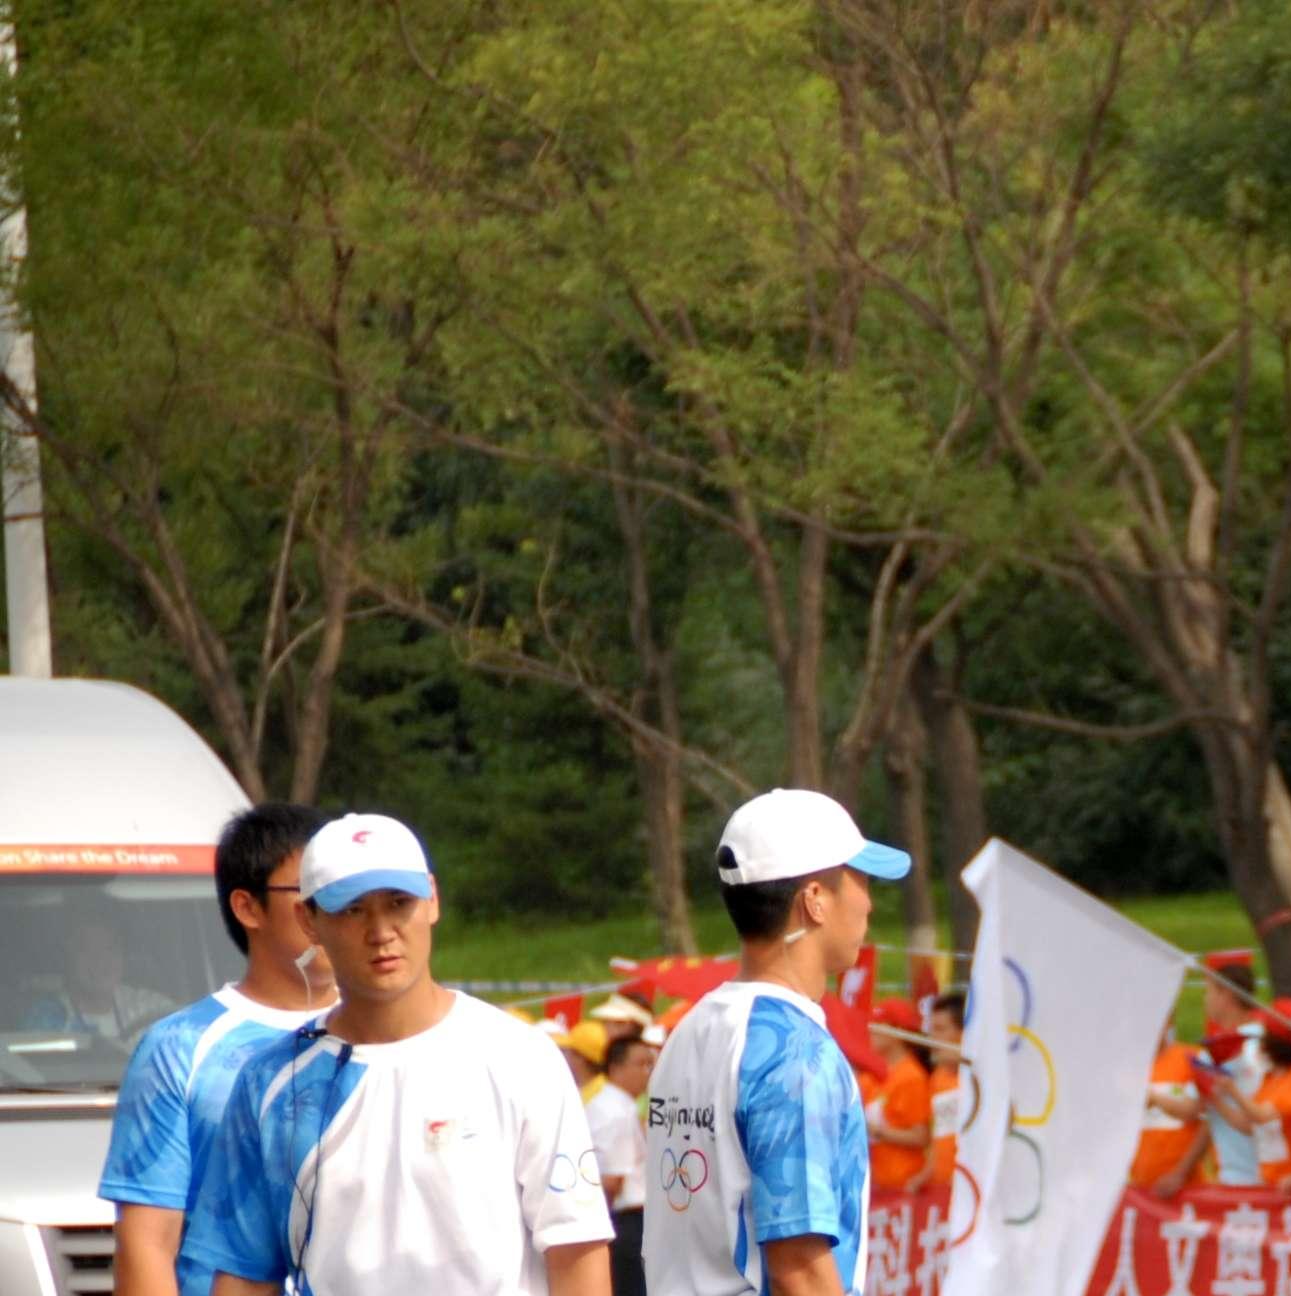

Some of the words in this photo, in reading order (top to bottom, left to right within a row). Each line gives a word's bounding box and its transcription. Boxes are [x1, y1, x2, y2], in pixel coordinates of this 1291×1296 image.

[22, 848, 78, 865] Share
[81, 849, 113, 865] the
[115, 848, 180, 865] Dream
